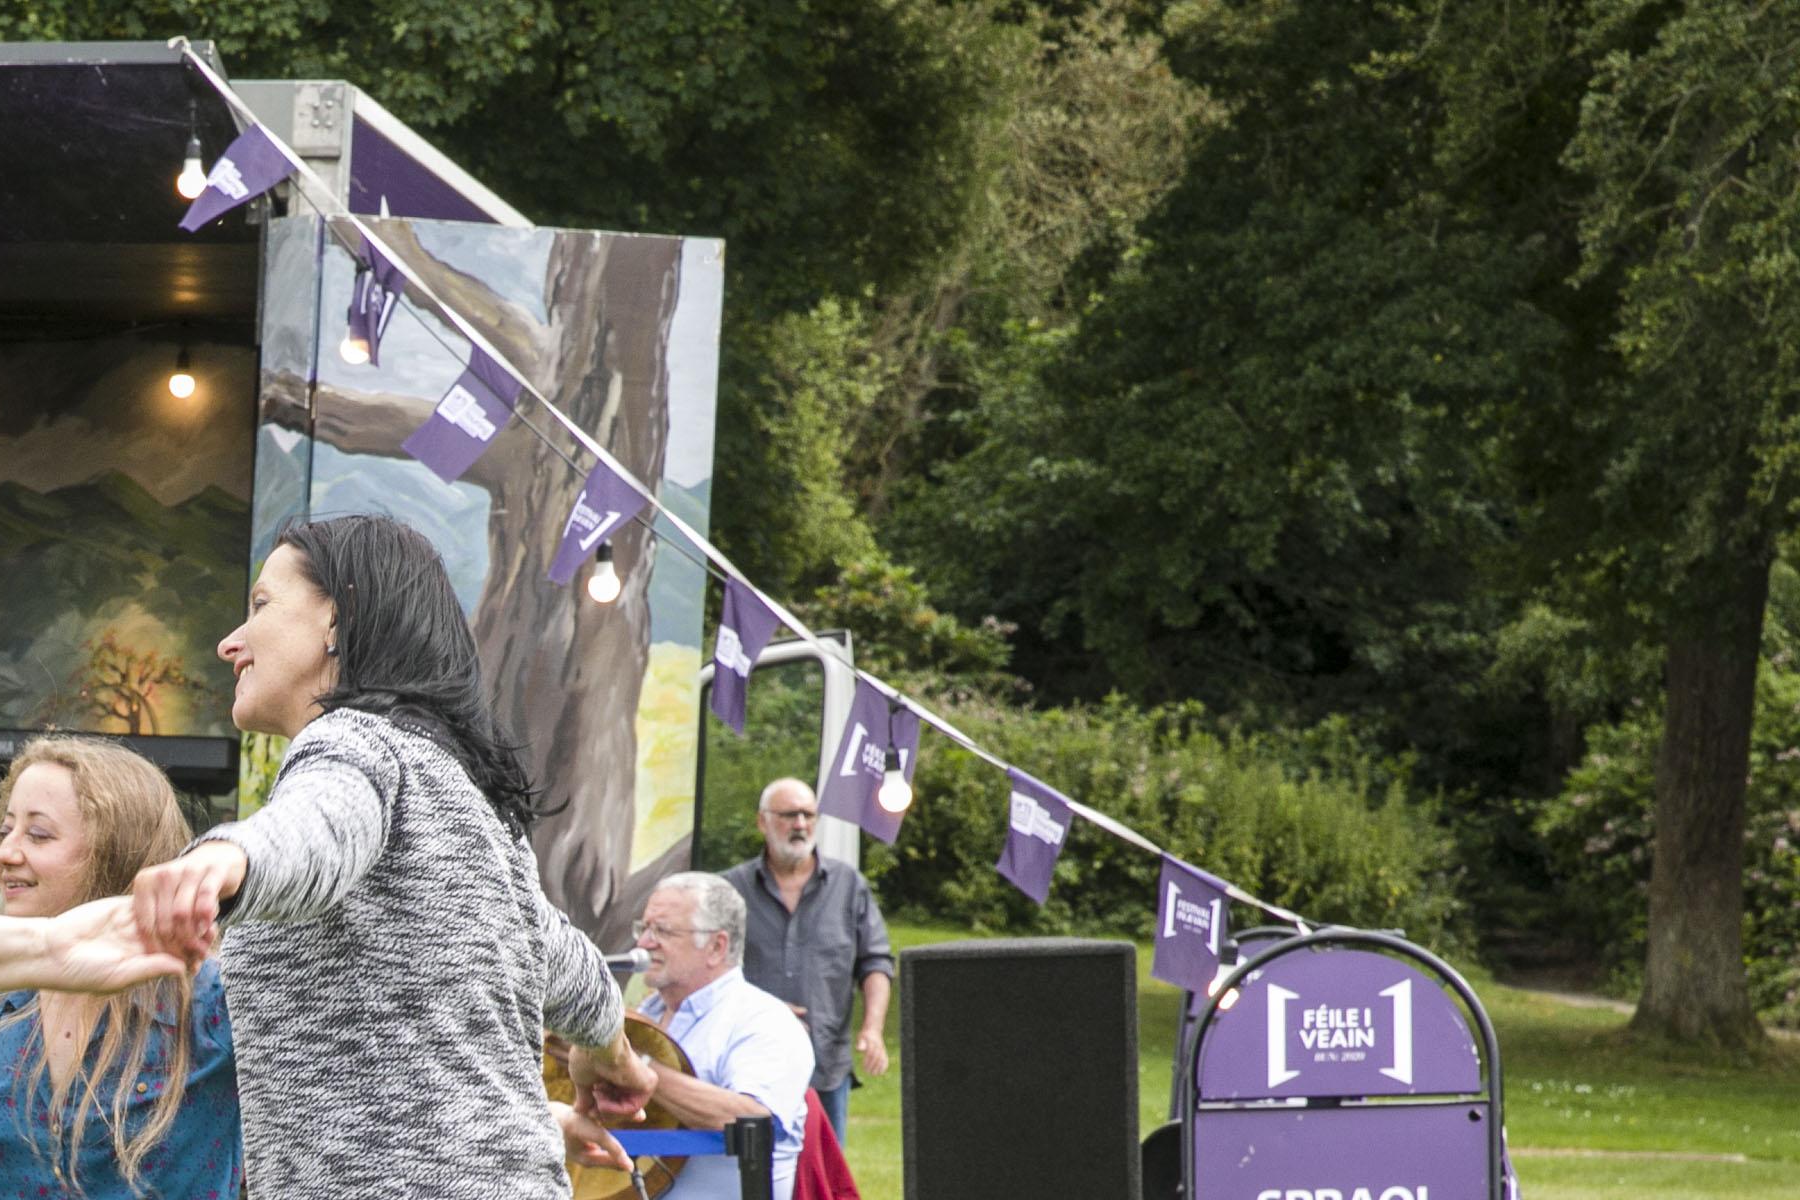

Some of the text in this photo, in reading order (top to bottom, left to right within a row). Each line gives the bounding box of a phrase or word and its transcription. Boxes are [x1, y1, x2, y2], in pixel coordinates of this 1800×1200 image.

[1303, 1004, 1372, 1029] FÉILE I
[1299, 1027, 1375, 1049] VEAIN
